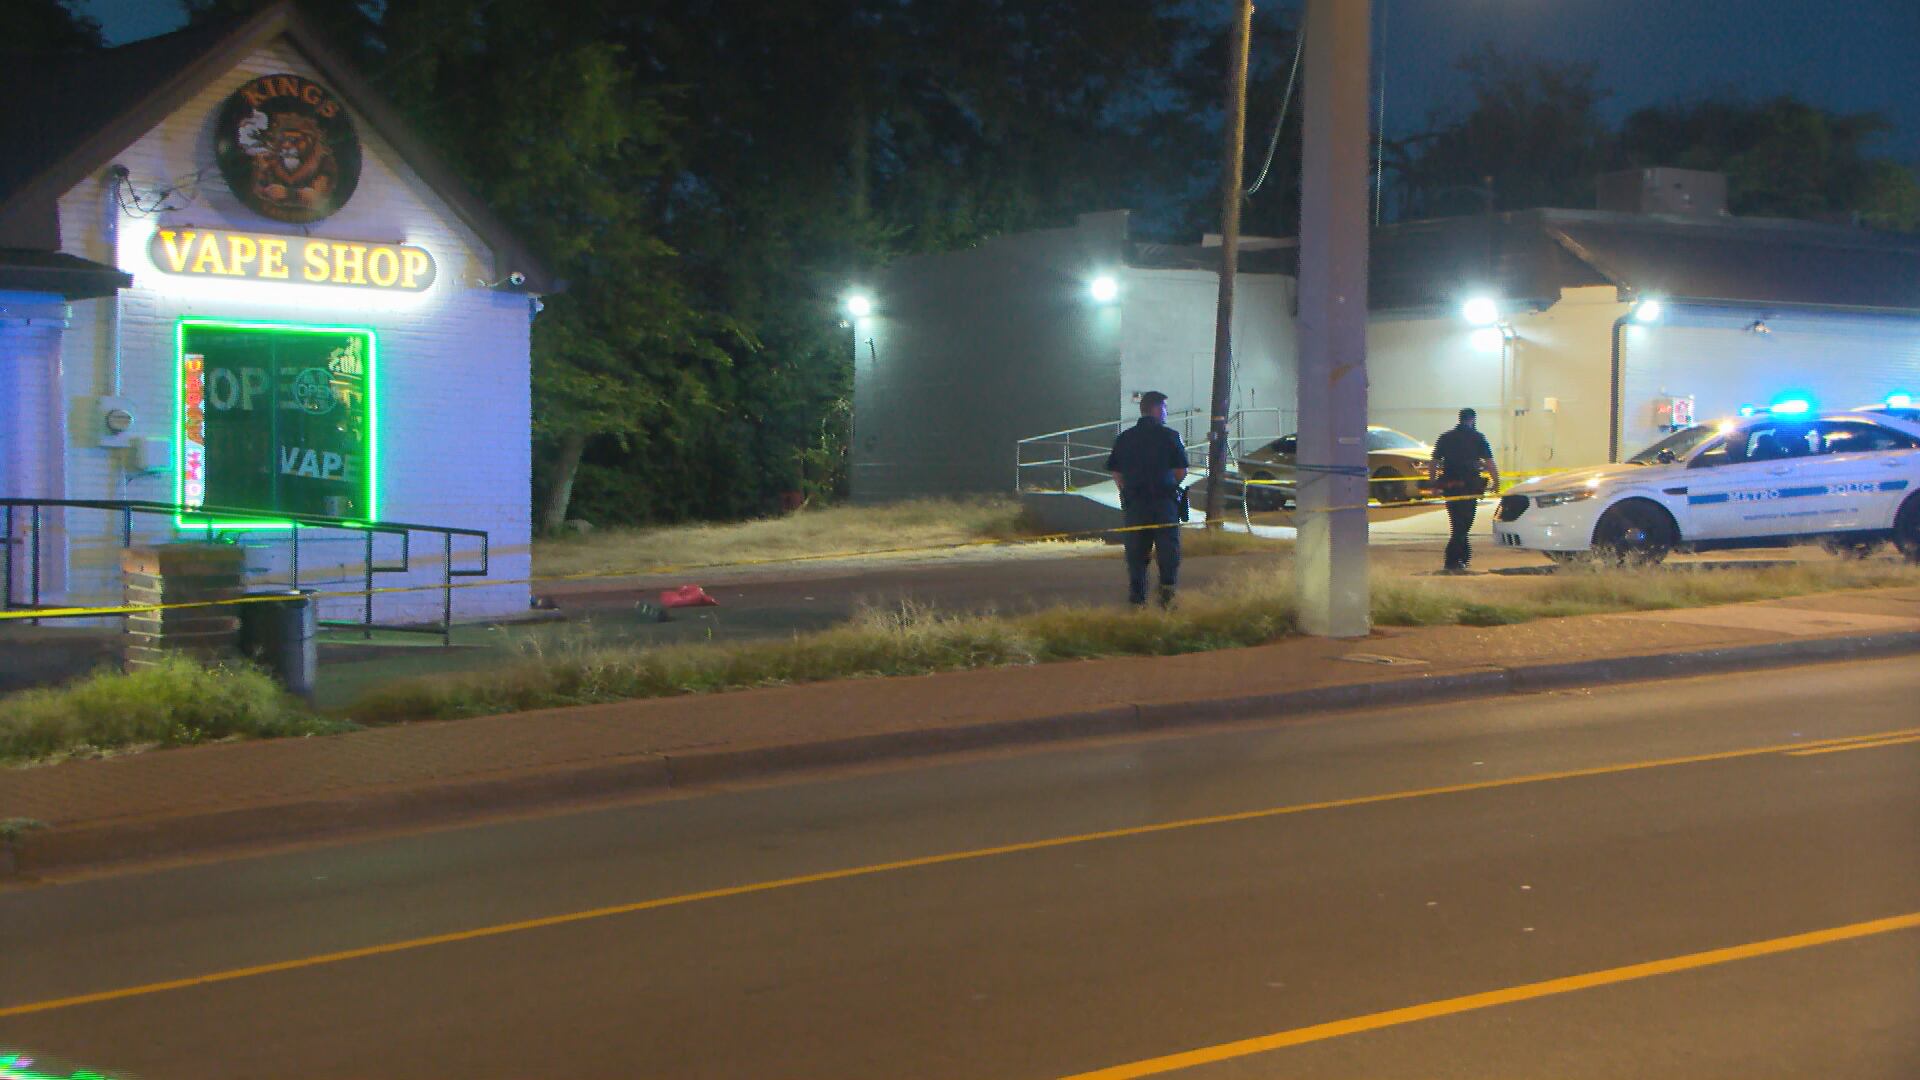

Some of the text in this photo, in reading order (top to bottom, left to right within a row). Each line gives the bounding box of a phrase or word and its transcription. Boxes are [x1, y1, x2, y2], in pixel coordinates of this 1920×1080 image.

[159, 230, 428, 287] VAPE SHOP
[1728, 482, 1880, 503] METRO POLICE
